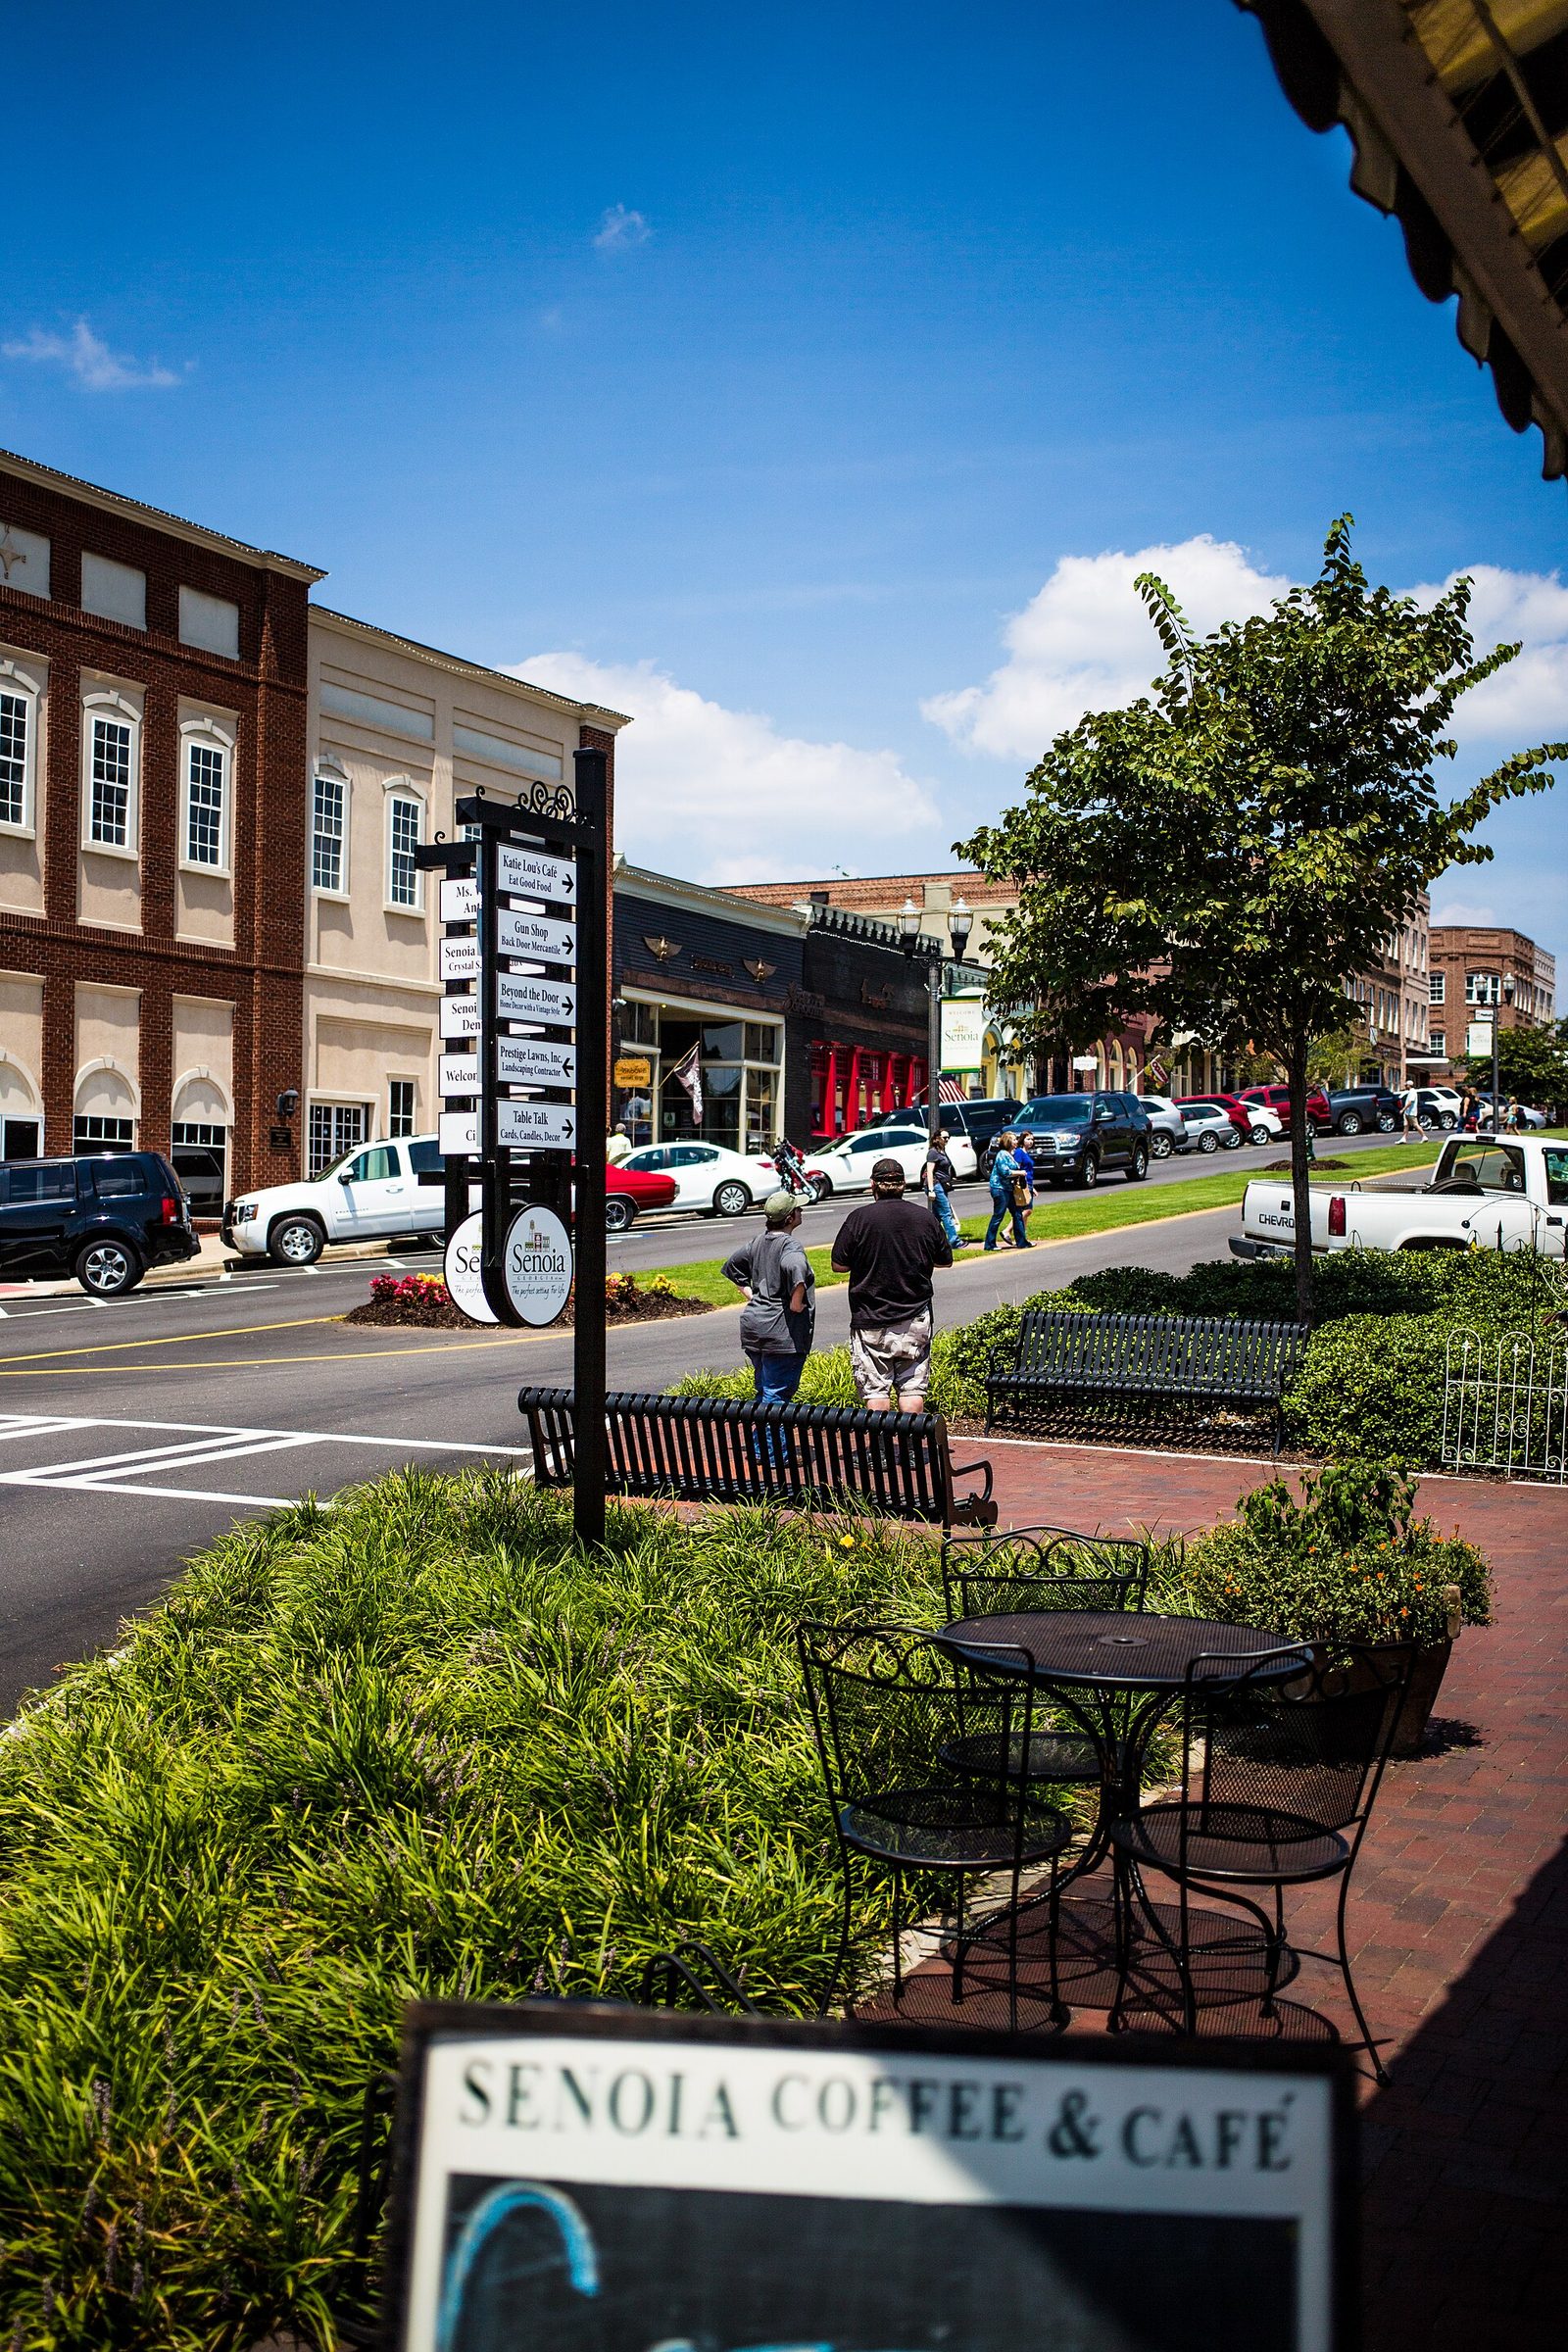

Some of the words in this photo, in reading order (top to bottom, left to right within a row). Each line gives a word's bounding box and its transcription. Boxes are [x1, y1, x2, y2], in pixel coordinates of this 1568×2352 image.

[503, 855, 522, 870] Katie
[523, 859, 541, 874] Lou's
[542, 864, 558, 878] Café
[509, 874, 518, 885] Eat
[519, 877, 535, 889] Good
[537, 880, 552, 892] Food
[457, 886, 472, 898] Ms.
[514, 920, 529, 935] Gun
[531, 923, 549, 941] Shop
[445, 946, 475, 958] Senoia
[501, 936, 515, 947] Back
[516, 938, 530, 950] Door
[531, 941, 561, 955] Mercantile
[449, 960, 474, 973] Crystal
[501, 983, 527, 1001] Beyond
[529, 988, 540, 1001] the
[542, 990, 560, 1004] Door
[452, 1003, 477, 1014] Senoi
[500, 1000, 512, 1008] Home
[536, 1004, 551, 1015] Vintage
[551, 1006, 561, 1016] Style
[463, 1019, 482, 1030] Den
[944, 1030, 979, 1042] Senoia
[500, 1046, 526, 1062] Prestige
[527, 1049, 549, 1063] Lawns,
[551, 1052, 563, 1063] Inc.
[502, 1062, 533, 1076] Landscaping
[534, 1065, 561, 1076] Contractor
[513, 1110, 532, 1124] Table
[533, 1112, 549, 1125] Talk
[500, 1129, 518, 1140] Cards,
[519, 1130, 543, 1142] Candles,
[544, 1131, 561, 1142] Decor
[1258, 1213, 1295, 1228] CHEVRO
[455, 1246, 480, 1273] Se
[512, 1244, 565, 1273] Senoia
[458, 2057, 742, 2140] SENOIA
[769, 2073, 1026, 2144] COFFEE
[1047, 2086, 1102, 2160] &
[1120, 2090, 1298, 2174] CAFÉ
